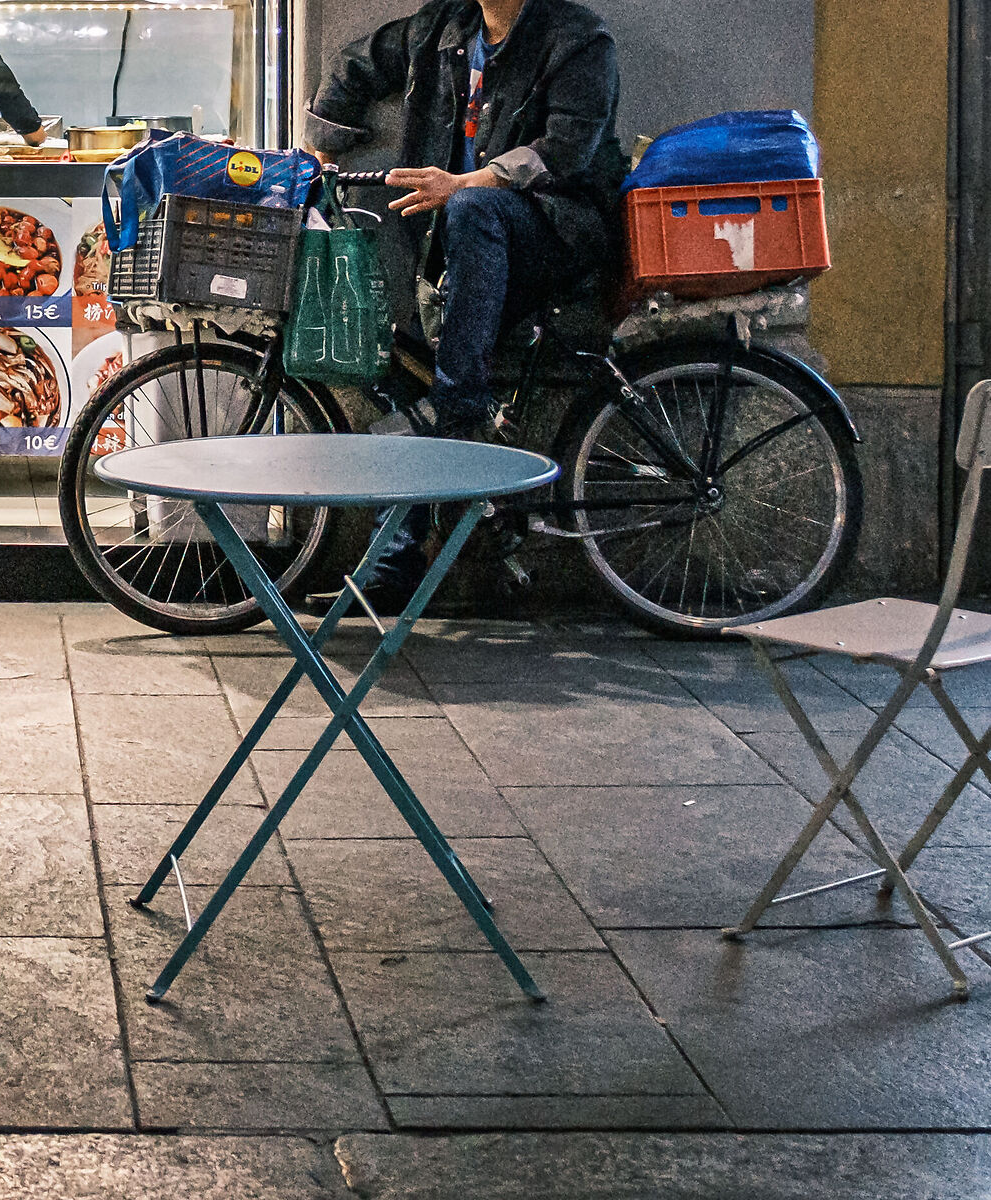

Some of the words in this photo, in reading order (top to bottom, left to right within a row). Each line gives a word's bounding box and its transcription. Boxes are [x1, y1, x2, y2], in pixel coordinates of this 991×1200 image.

[92, 282, 107, 291] Trip
[24, 304, 60, 320] 15€
[24, 435, 60, 450] 10€
